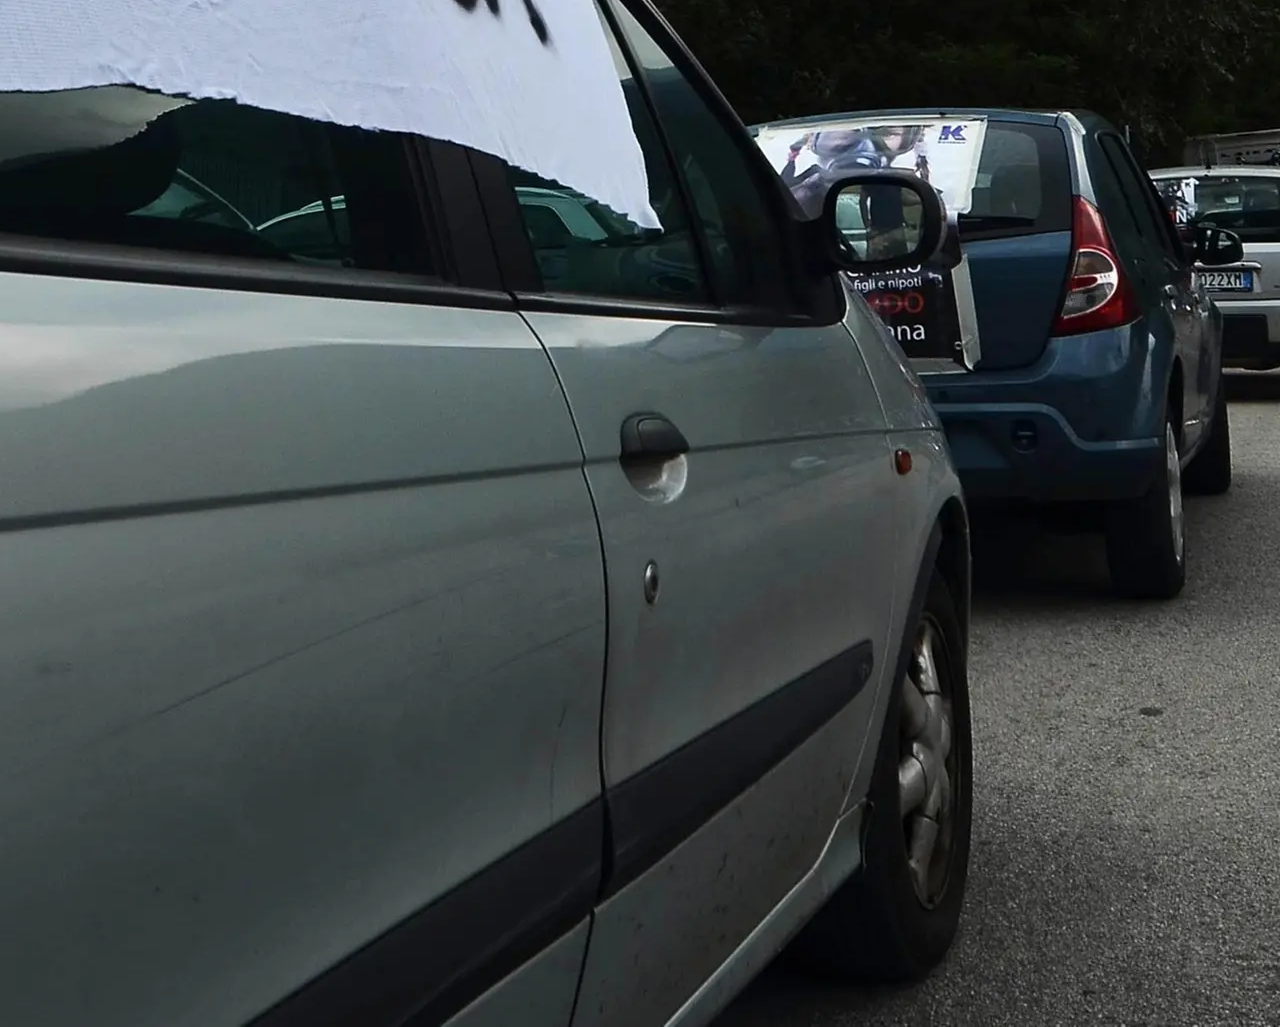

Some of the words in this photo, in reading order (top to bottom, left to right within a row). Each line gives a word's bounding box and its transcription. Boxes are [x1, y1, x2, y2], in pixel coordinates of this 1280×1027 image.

[939, 125, 966, 140] K
[854, 279, 876, 293] figli
[878, 280, 885, 289] e
[888, 276, 922, 290] nipoti
